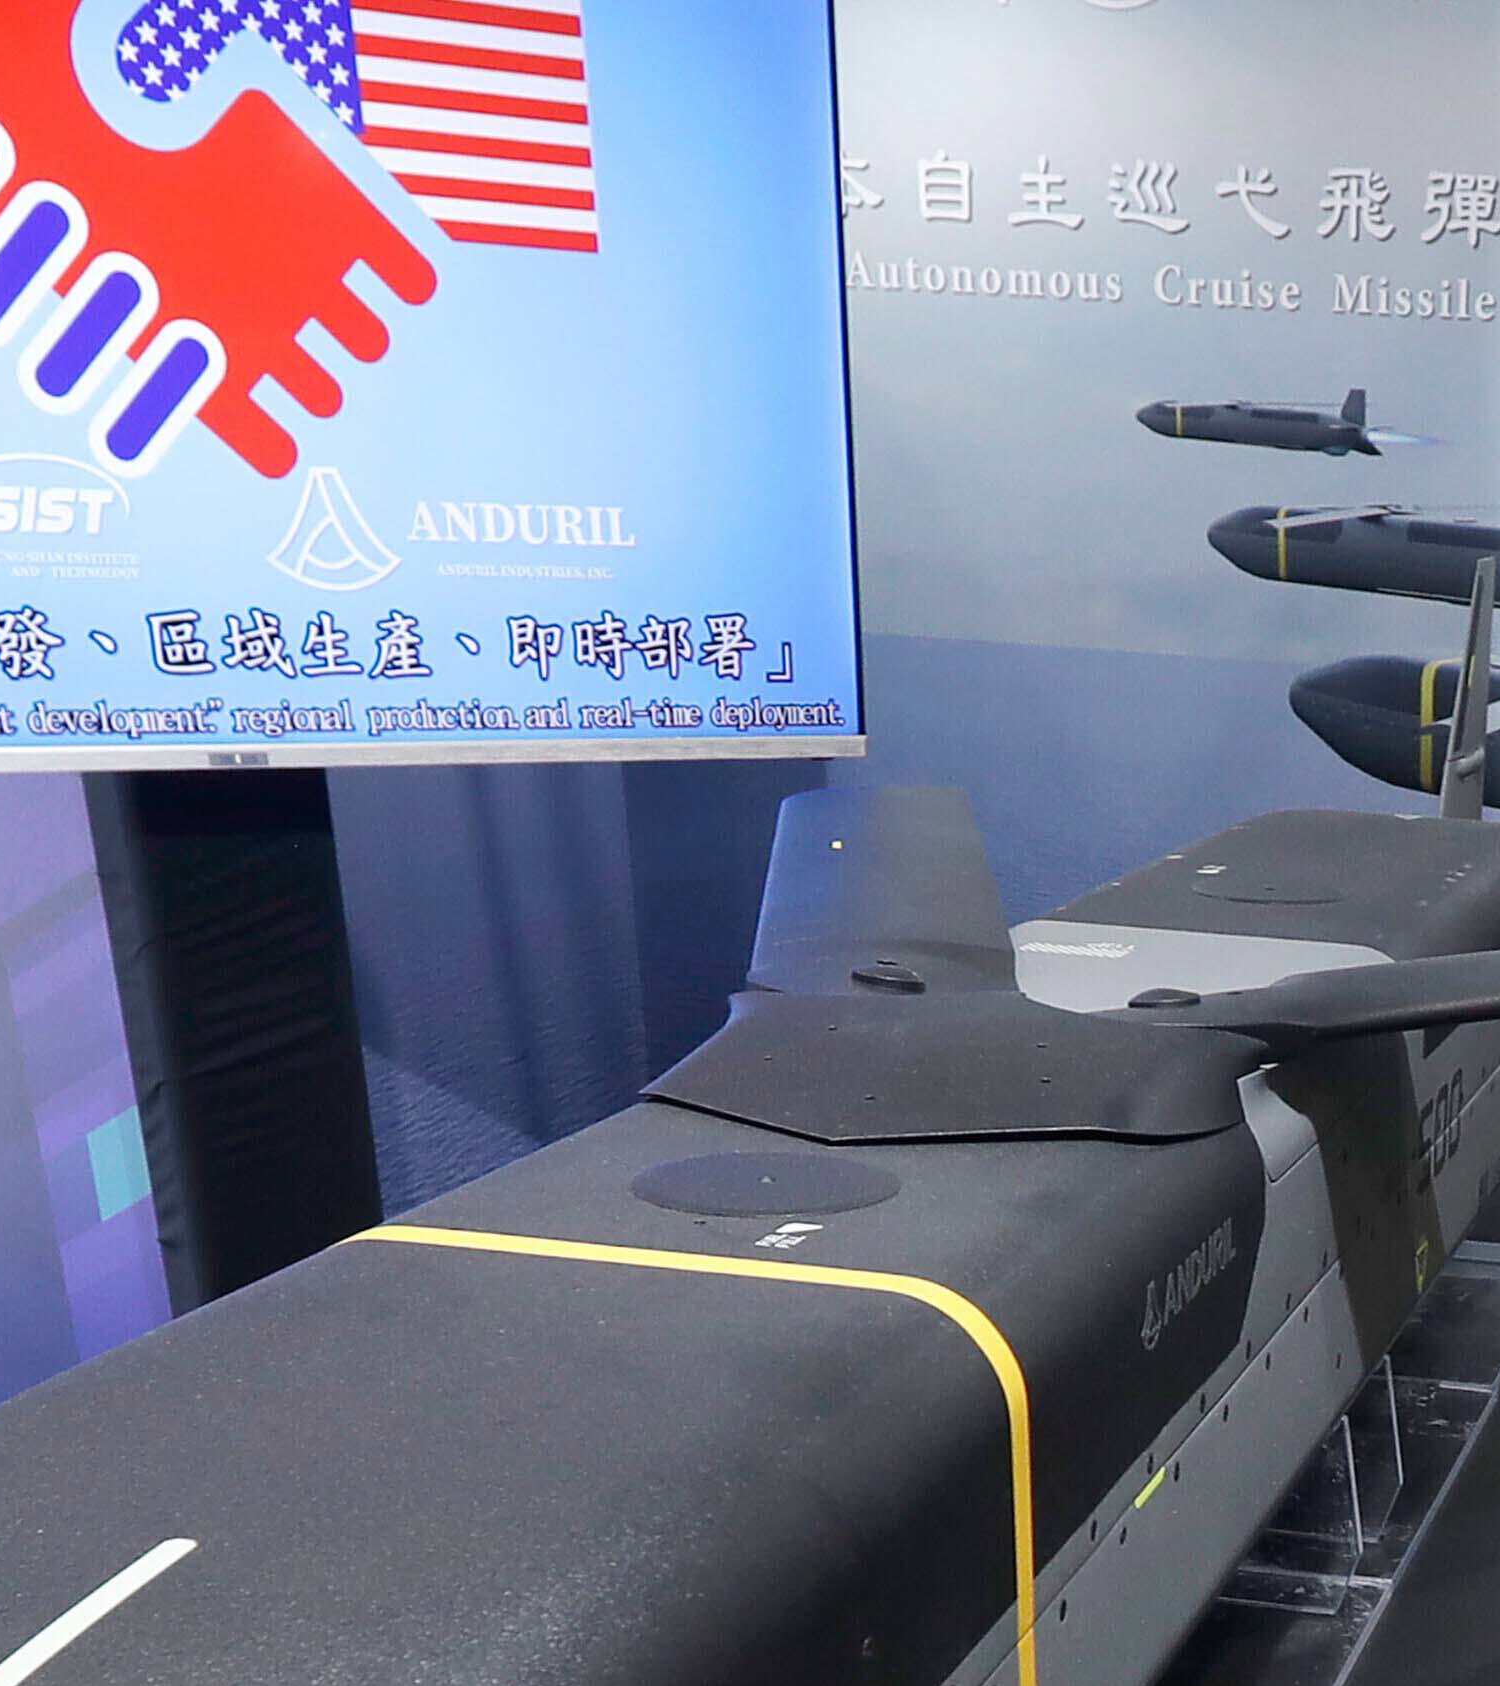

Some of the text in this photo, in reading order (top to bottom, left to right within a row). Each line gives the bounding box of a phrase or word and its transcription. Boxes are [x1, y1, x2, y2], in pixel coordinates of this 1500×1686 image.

[846, 249, 1498, 322] Autonomous Cruise Missile
[407, 500, 637, 547] ANDURIL
[231, 699, 355, 737] regional
[524, 697, 571, 729] and
[579, 697, 703, 729] real-time
[710, 697, 846, 732] deployment.
[1163, 1216, 1237, 1327] ANDURIL
